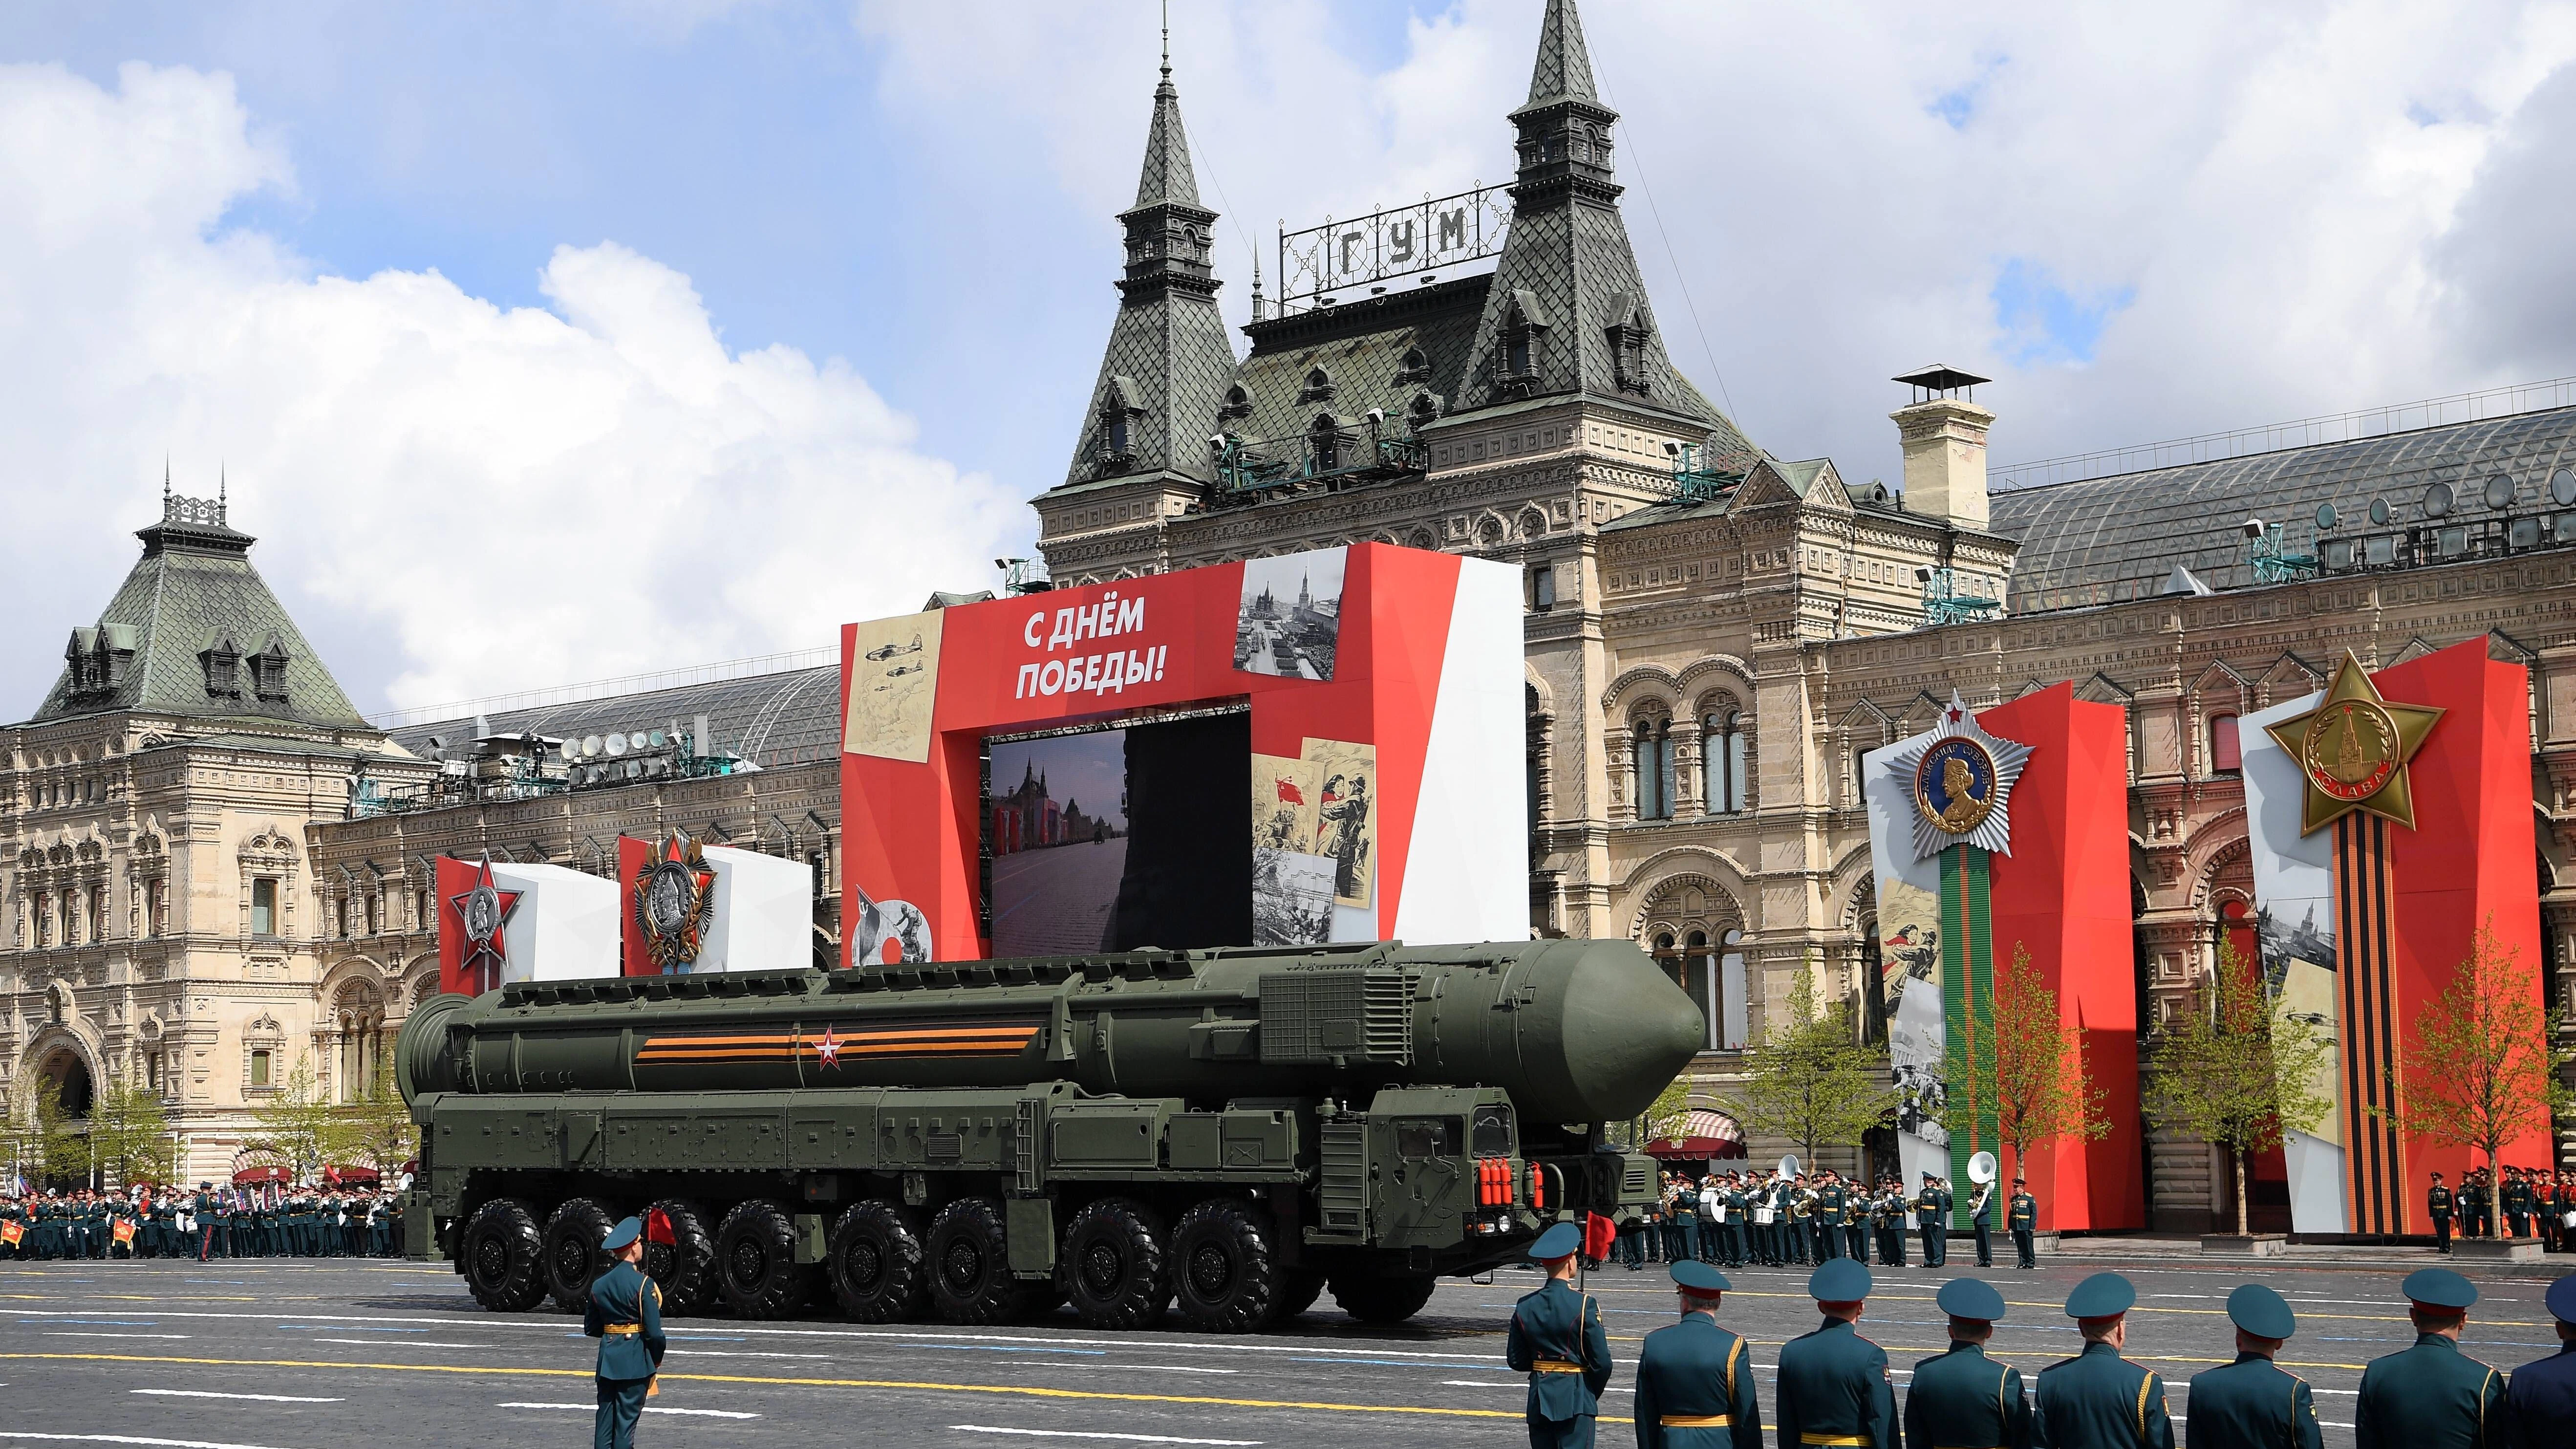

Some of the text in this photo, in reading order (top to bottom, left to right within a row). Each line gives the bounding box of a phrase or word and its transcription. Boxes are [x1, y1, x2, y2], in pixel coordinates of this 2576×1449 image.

[1342, 207, 1464, 275] ГУМ
[1024, 590, 1145, 651] С ДНЁМ
[1015, 645, 1167, 699] ПОБЕДЫ!
[1963, 746, 1990, 784] СУВОРОВ
[2321, 772, 2384, 797] СЛАВА
